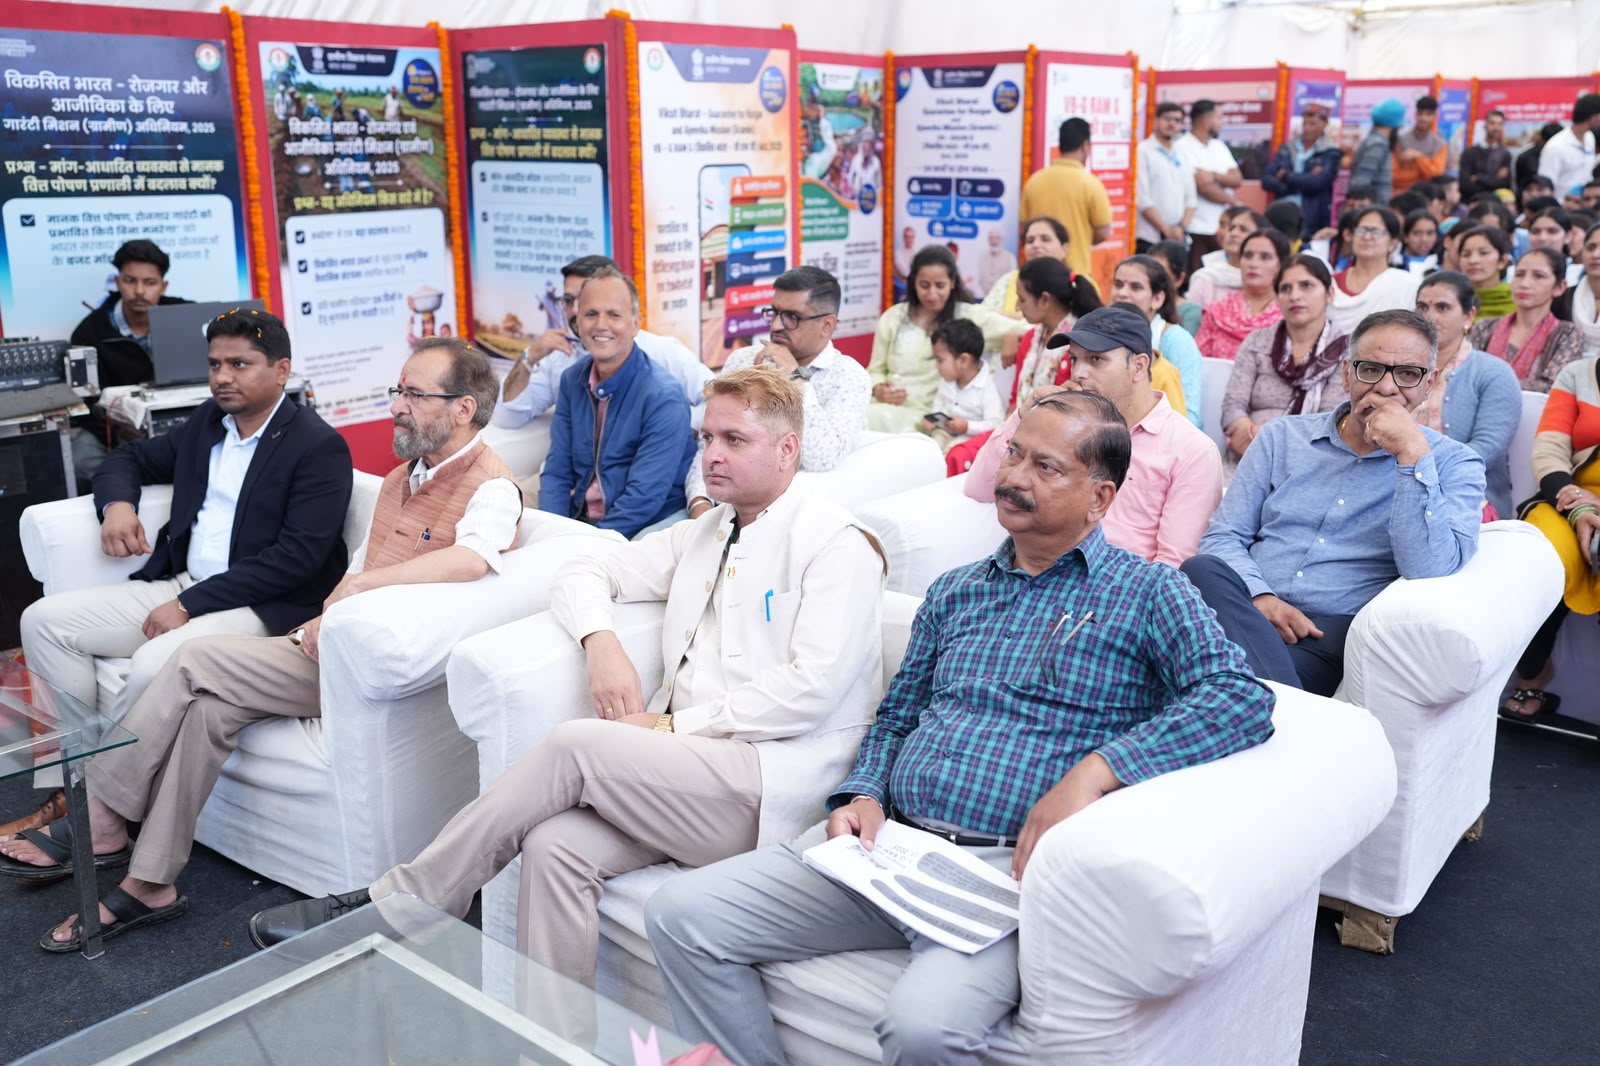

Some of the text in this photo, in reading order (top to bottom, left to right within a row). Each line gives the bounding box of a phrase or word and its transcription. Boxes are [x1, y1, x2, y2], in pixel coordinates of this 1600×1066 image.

[5, 69, 70, 91] विकसित
[74, 76, 112, 92] भारत
[129, 74, 179, 94] रोजगार
[183, 75, 208, 95] और
[52, 94, 175, 114] आजीविका के लिए
[1090, 96, 1111, 115] RAM
[3, 116, 215, 135] गारंटी मिशन (ग्रामीण) अधिनियम, 2025
[288, 116, 331, 135] विकसित
[333, 120, 359, 135] भारत
[366, 119, 402, 135] रोजगार
[284, 136, 434, 156] आजीविका गारंटी मिशन (ग्रामीण)
[5, 160, 35, 175] प्रश्न
[135, 159, 177, 173] व्यवस्था
[178, 156, 190, 172] से
[191, 159, 224, 172] मानक
[375, 161, 400, 175] 2025
[22, 174, 217, 193] वित्त पोषण प्रणाली में बदलाव क्यों?
